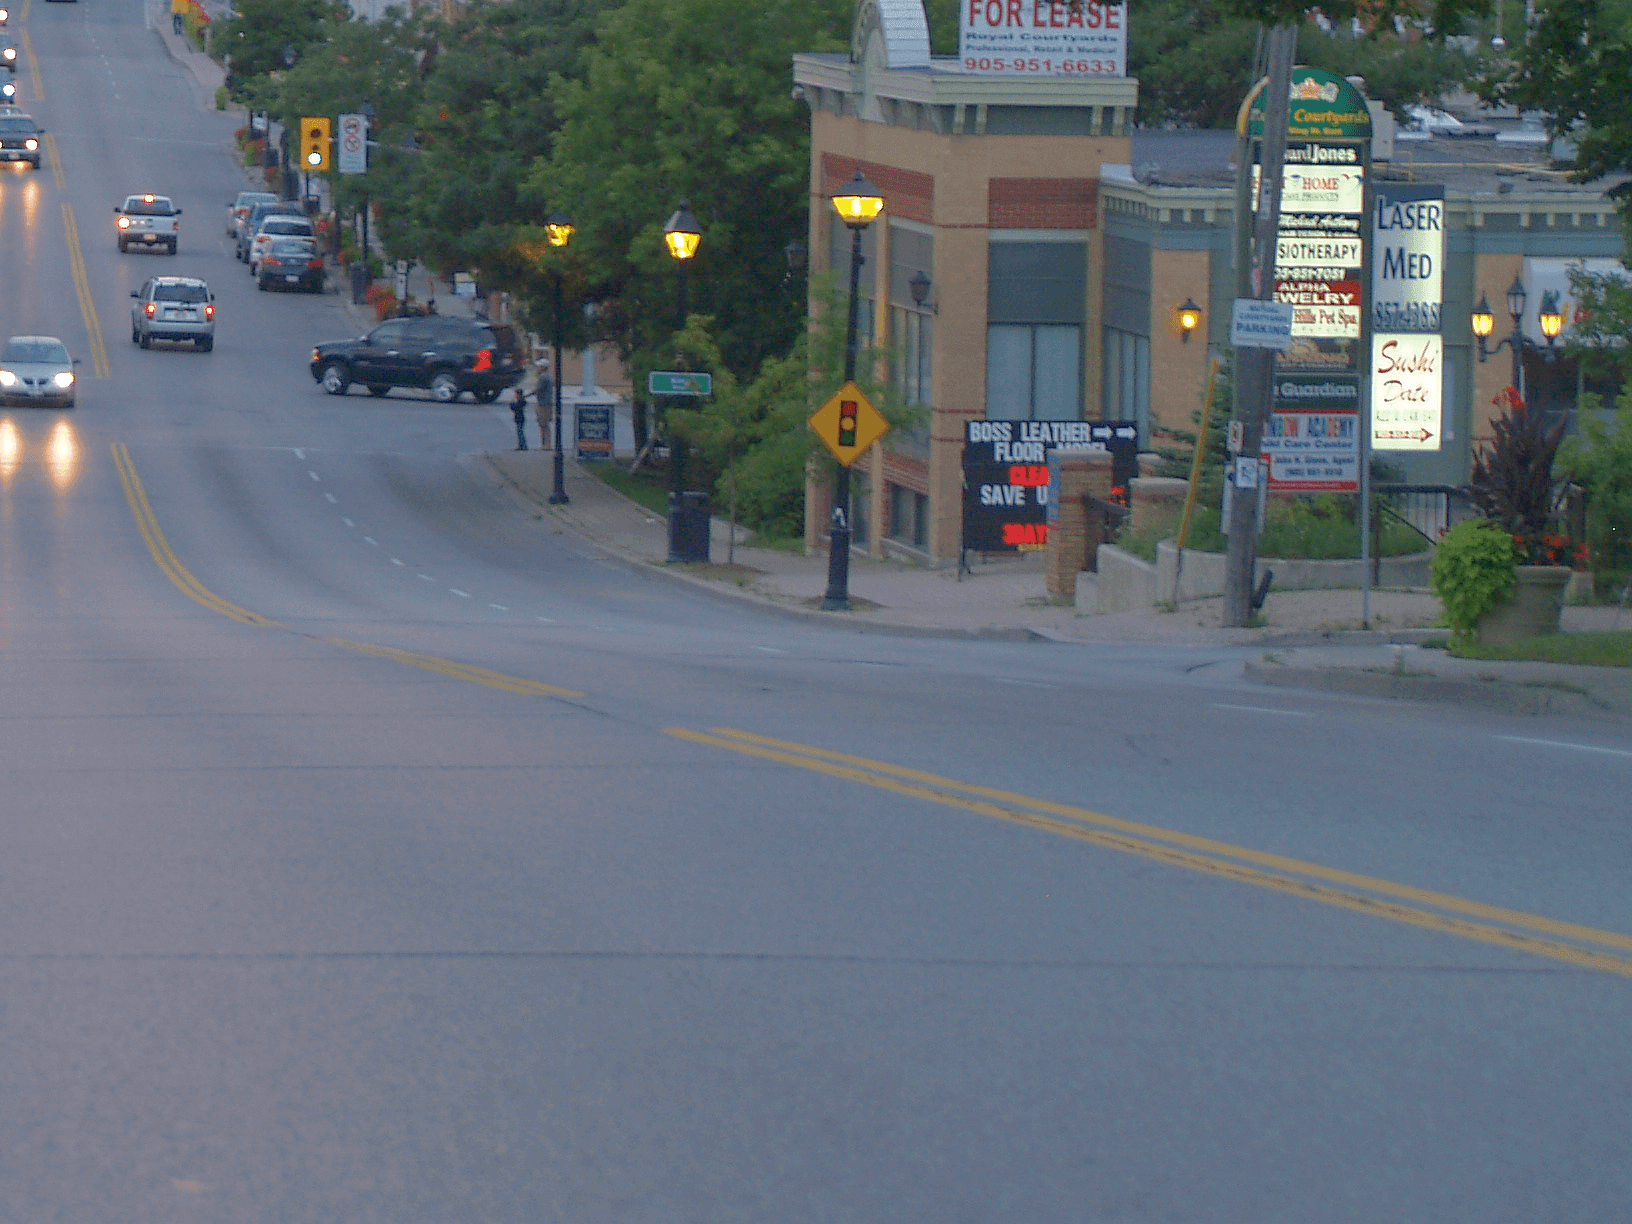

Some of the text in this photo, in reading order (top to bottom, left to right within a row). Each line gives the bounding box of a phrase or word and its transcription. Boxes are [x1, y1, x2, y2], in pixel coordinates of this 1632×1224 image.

[965, 58, 1116, 73] 905-951-6633
[1302, 178, 1338, 190] HOME
[1378, 197, 1440, 230] LASER
[1278, 243, 1357, 259] SIOTHERAPY
[1383, 247, 1432, 279] MED
[1278, 282, 1331, 292] ALPHA
[1272, 292, 1354, 305] EWELRY
[1378, 340, 1439, 374] Sushi
[1280, 381, 1357, 397] Guardian
[969, 421, 1091, 442] BOSS LEATHER
[994, 441, 1046, 462] FLOOR
[980, 484, 1048, 505] SAVE U
